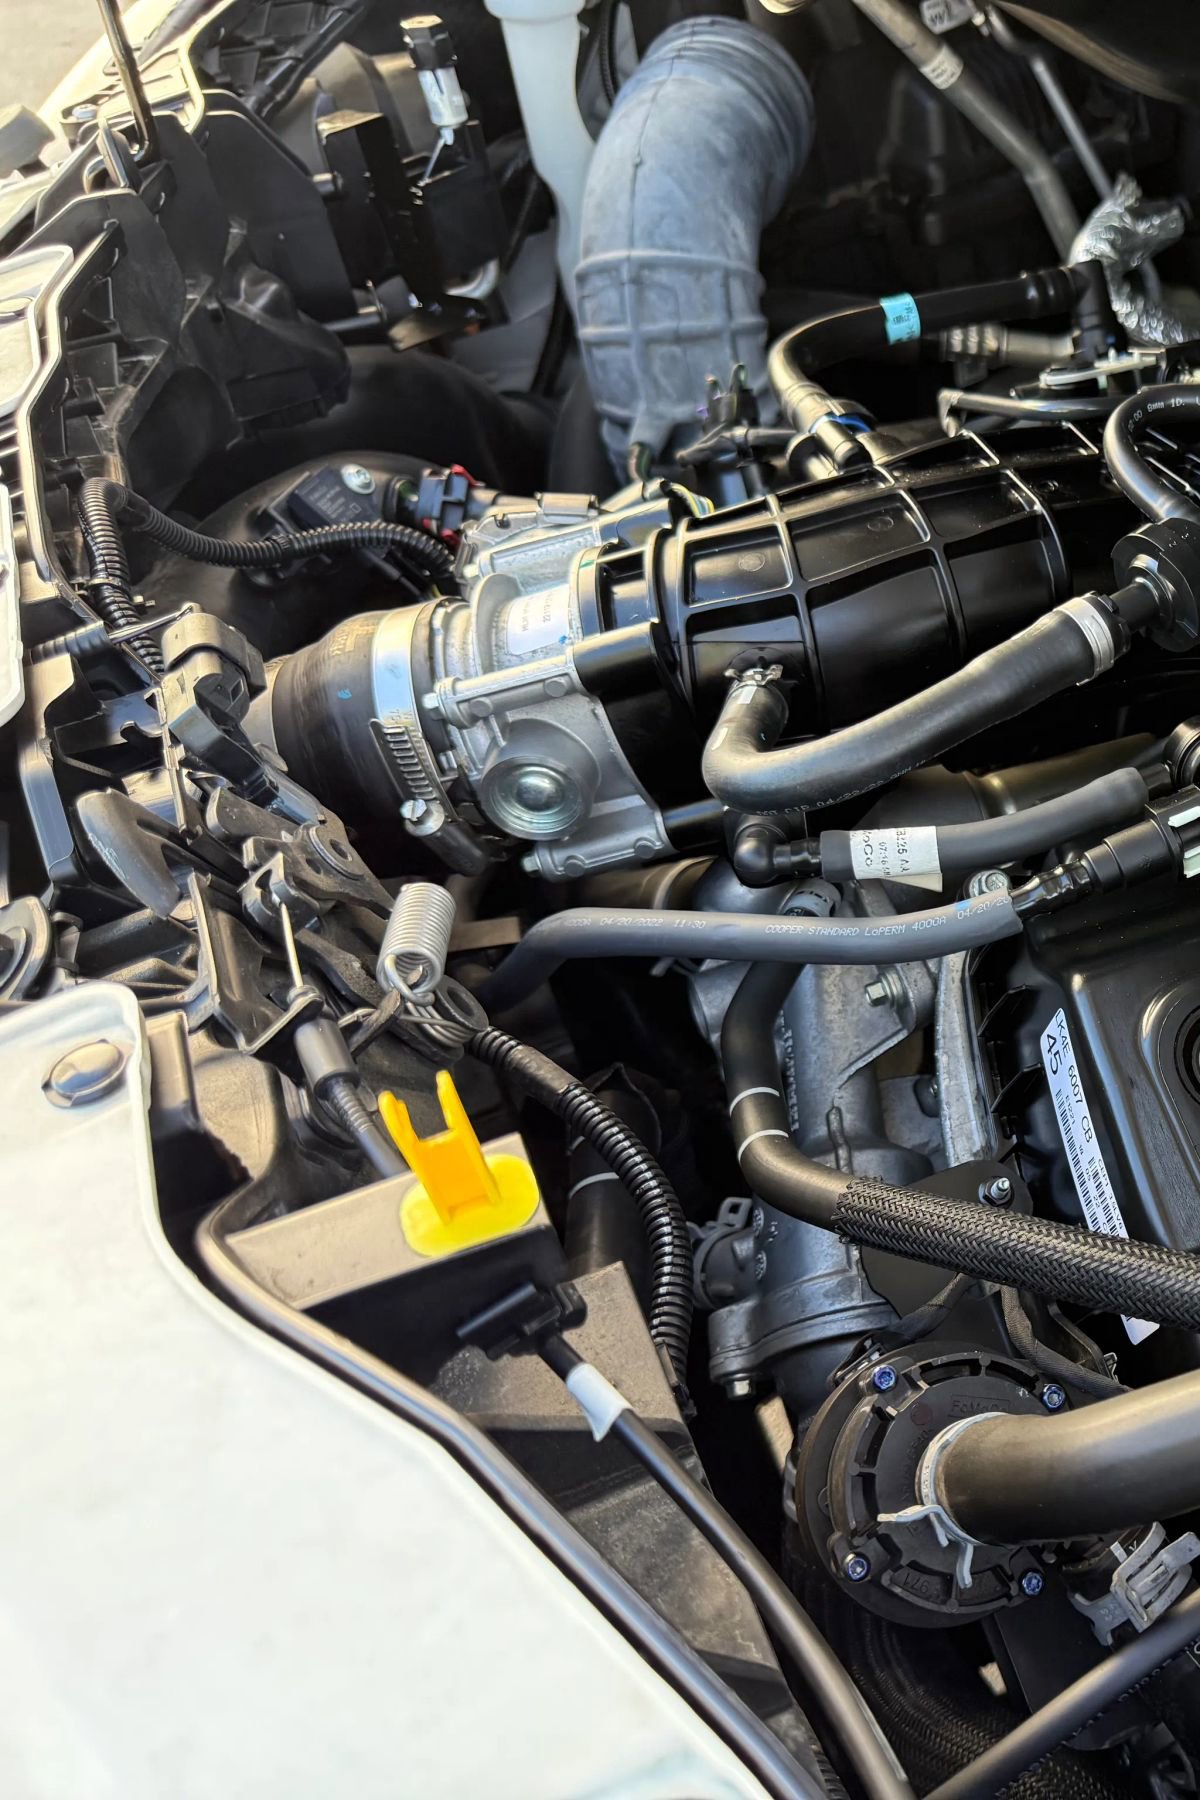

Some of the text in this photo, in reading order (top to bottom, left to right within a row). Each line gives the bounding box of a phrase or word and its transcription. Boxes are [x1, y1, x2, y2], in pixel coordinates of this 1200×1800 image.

[764, 922, 806, 936] COOPER
[808, 923, 860, 938] STANDARD
[1046, 1033, 1063, 1076] 45
[1055, 1008, 1093, 1143] LK4E 6007 CB
